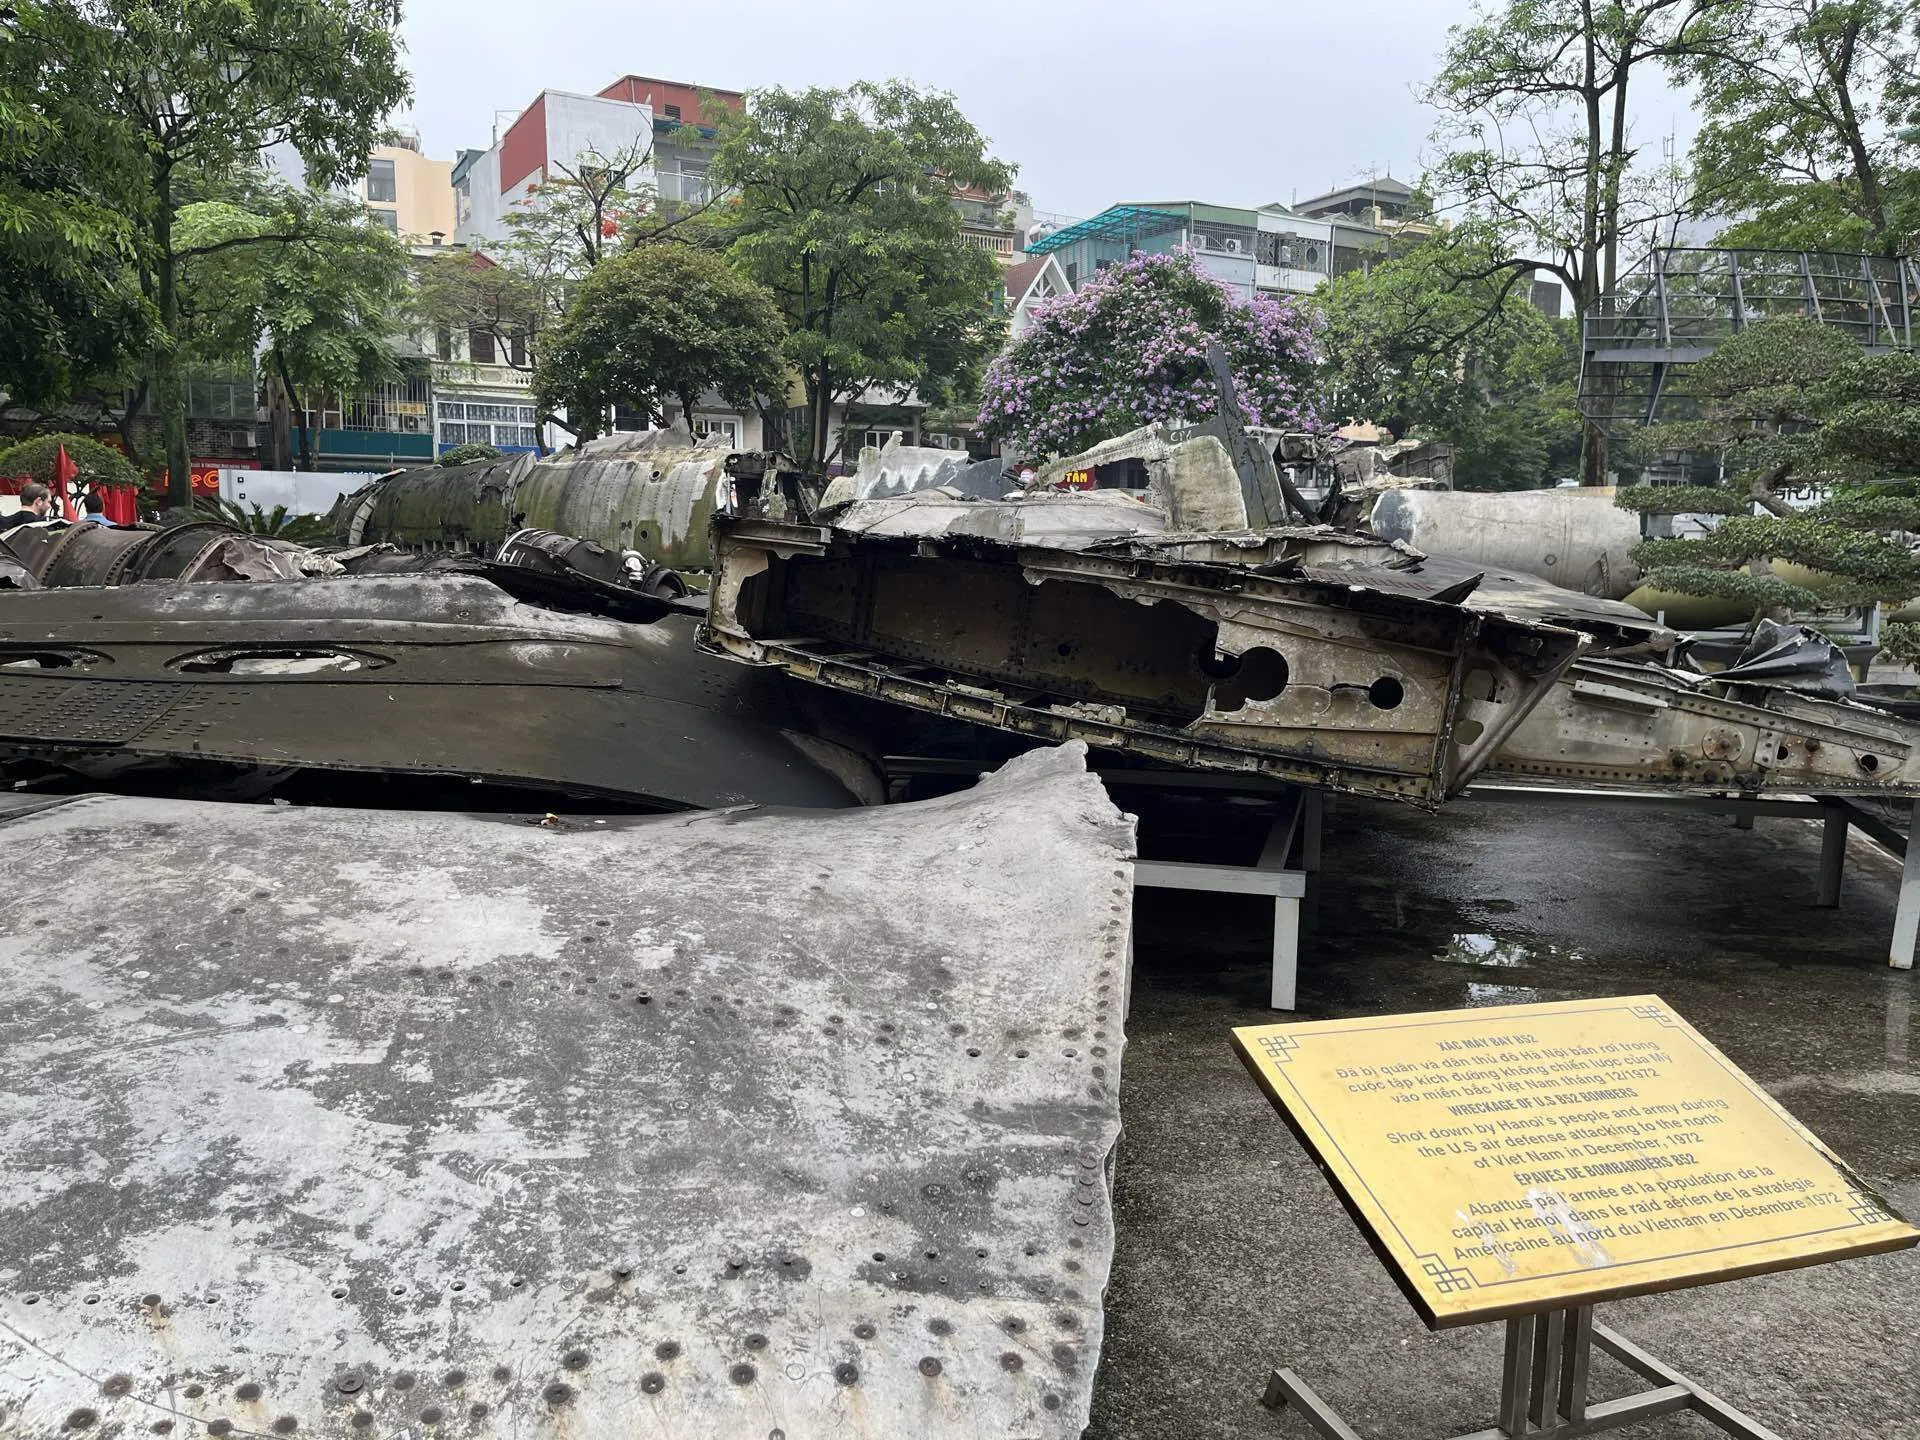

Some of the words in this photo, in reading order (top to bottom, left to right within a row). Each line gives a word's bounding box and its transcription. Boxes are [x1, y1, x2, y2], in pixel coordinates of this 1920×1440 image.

[1436, 1040, 1462, 1052] XÁC
[1462, 1037, 1489, 1049] MÁY
[1489, 1035, 1513, 1047] BAY
[1513, 1034, 1539, 1045] B52
[1520, 1051, 1542, 1061] Hà
[1541, 1047, 1568, 1060] Nội
[1619, 1041, 1660, 1052] trong
[1391, 1090, 1420, 1104] vào
[1492, 1080, 1525, 1093] Việt
[1524, 1078, 1561, 1090] Nam
[1561, 1073, 1606, 1085] tháng
[1605, 1067, 1661, 1081] 12/1972
[1415, 1074, 1449, 1087] kích
[1499, 1065, 1550, 1077] không
[1448, 1099, 1518, 1117] WRECKAGE
[1517, 1097, 1534, 1109] OF
[1535, 1095, 1557, 1108] U.S
[1555, 1092, 1582, 1105] B52
[1580, 1087, 1639, 1103] BOMBERS
[1386, 1130, 1427, 1145] Shot
[1429, 1124, 1473, 1141] down
[1474, 1121, 1497, 1136] by
[1496, 1115, 1557, 1132] Hanoi's
[1559, 1109, 1610, 1127] people
[1612, 1106, 1641, 1119] and
[1641, 1102, 1680, 1115] army
[1680, 1098, 1729, 1110] during
[1417, 1145, 1446, 1158] the
[1447, 1140, 1478, 1154] U.S
[1480, 1138, 1501, 1150] air
[1505, 1130, 1567, 1147] defense
[1569, 1123, 1640, 1140] attacking
[1639, 1120, 1655, 1132] to
[1655, 1117, 1682, 1130] the
[1683, 1113, 1724, 1127] north
[1474, 1157, 1491, 1169] of
[1492, 1152, 1526, 1167] Viet
[1525, 1149, 1565, 1163] Nam
[1566, 1146, 1584, 1158] in
[1666, 1132, 1704, 1146] 1972
[1565, 1166, 1586, 1180] DE
[1585, 1155, 1674, 1177] BOMBARDIERS
[1670, 1152, 1699, 1167] B52
[1452, 1220, 1510, 1240] capital
[1510, 1213, 1561, 1231] Hanoi
[1567, 1206, 1610, 1223] dans
[1609, 1203, 1628, 1217] le
[1630, 1200, 1662, 1214] raid
[1664, 1193, 1712, 1210] aérien
[1713, 1189, 1735, 1202] de
[1736, 1186, 1752, 1199] la
[1751, 1177, 1816, 1197] stratégie
[1468, 1198, 1533, 1217] Abattus
[1620, 1183, 1639, 1196] et
[1639, 1181, 1654, 1194] la
[1656, 1170, 1735, 1195] population
[1736, 1167, 1758, 1180] de
[1758, 1165, 1775, 1177] la
[1453, 1236, 1550, 1261] Américaine
[1552, 1233, 1576, 1246] au
[1577, 1225, 1616, 1242] nord
[1618, 1220, 1643, 1236] du
[1641, 1213, 1708, 1234] Vietnam
[1709, 1210, 1731, 1223] en
[1728, 1198, 1807, 1219] Décembre
